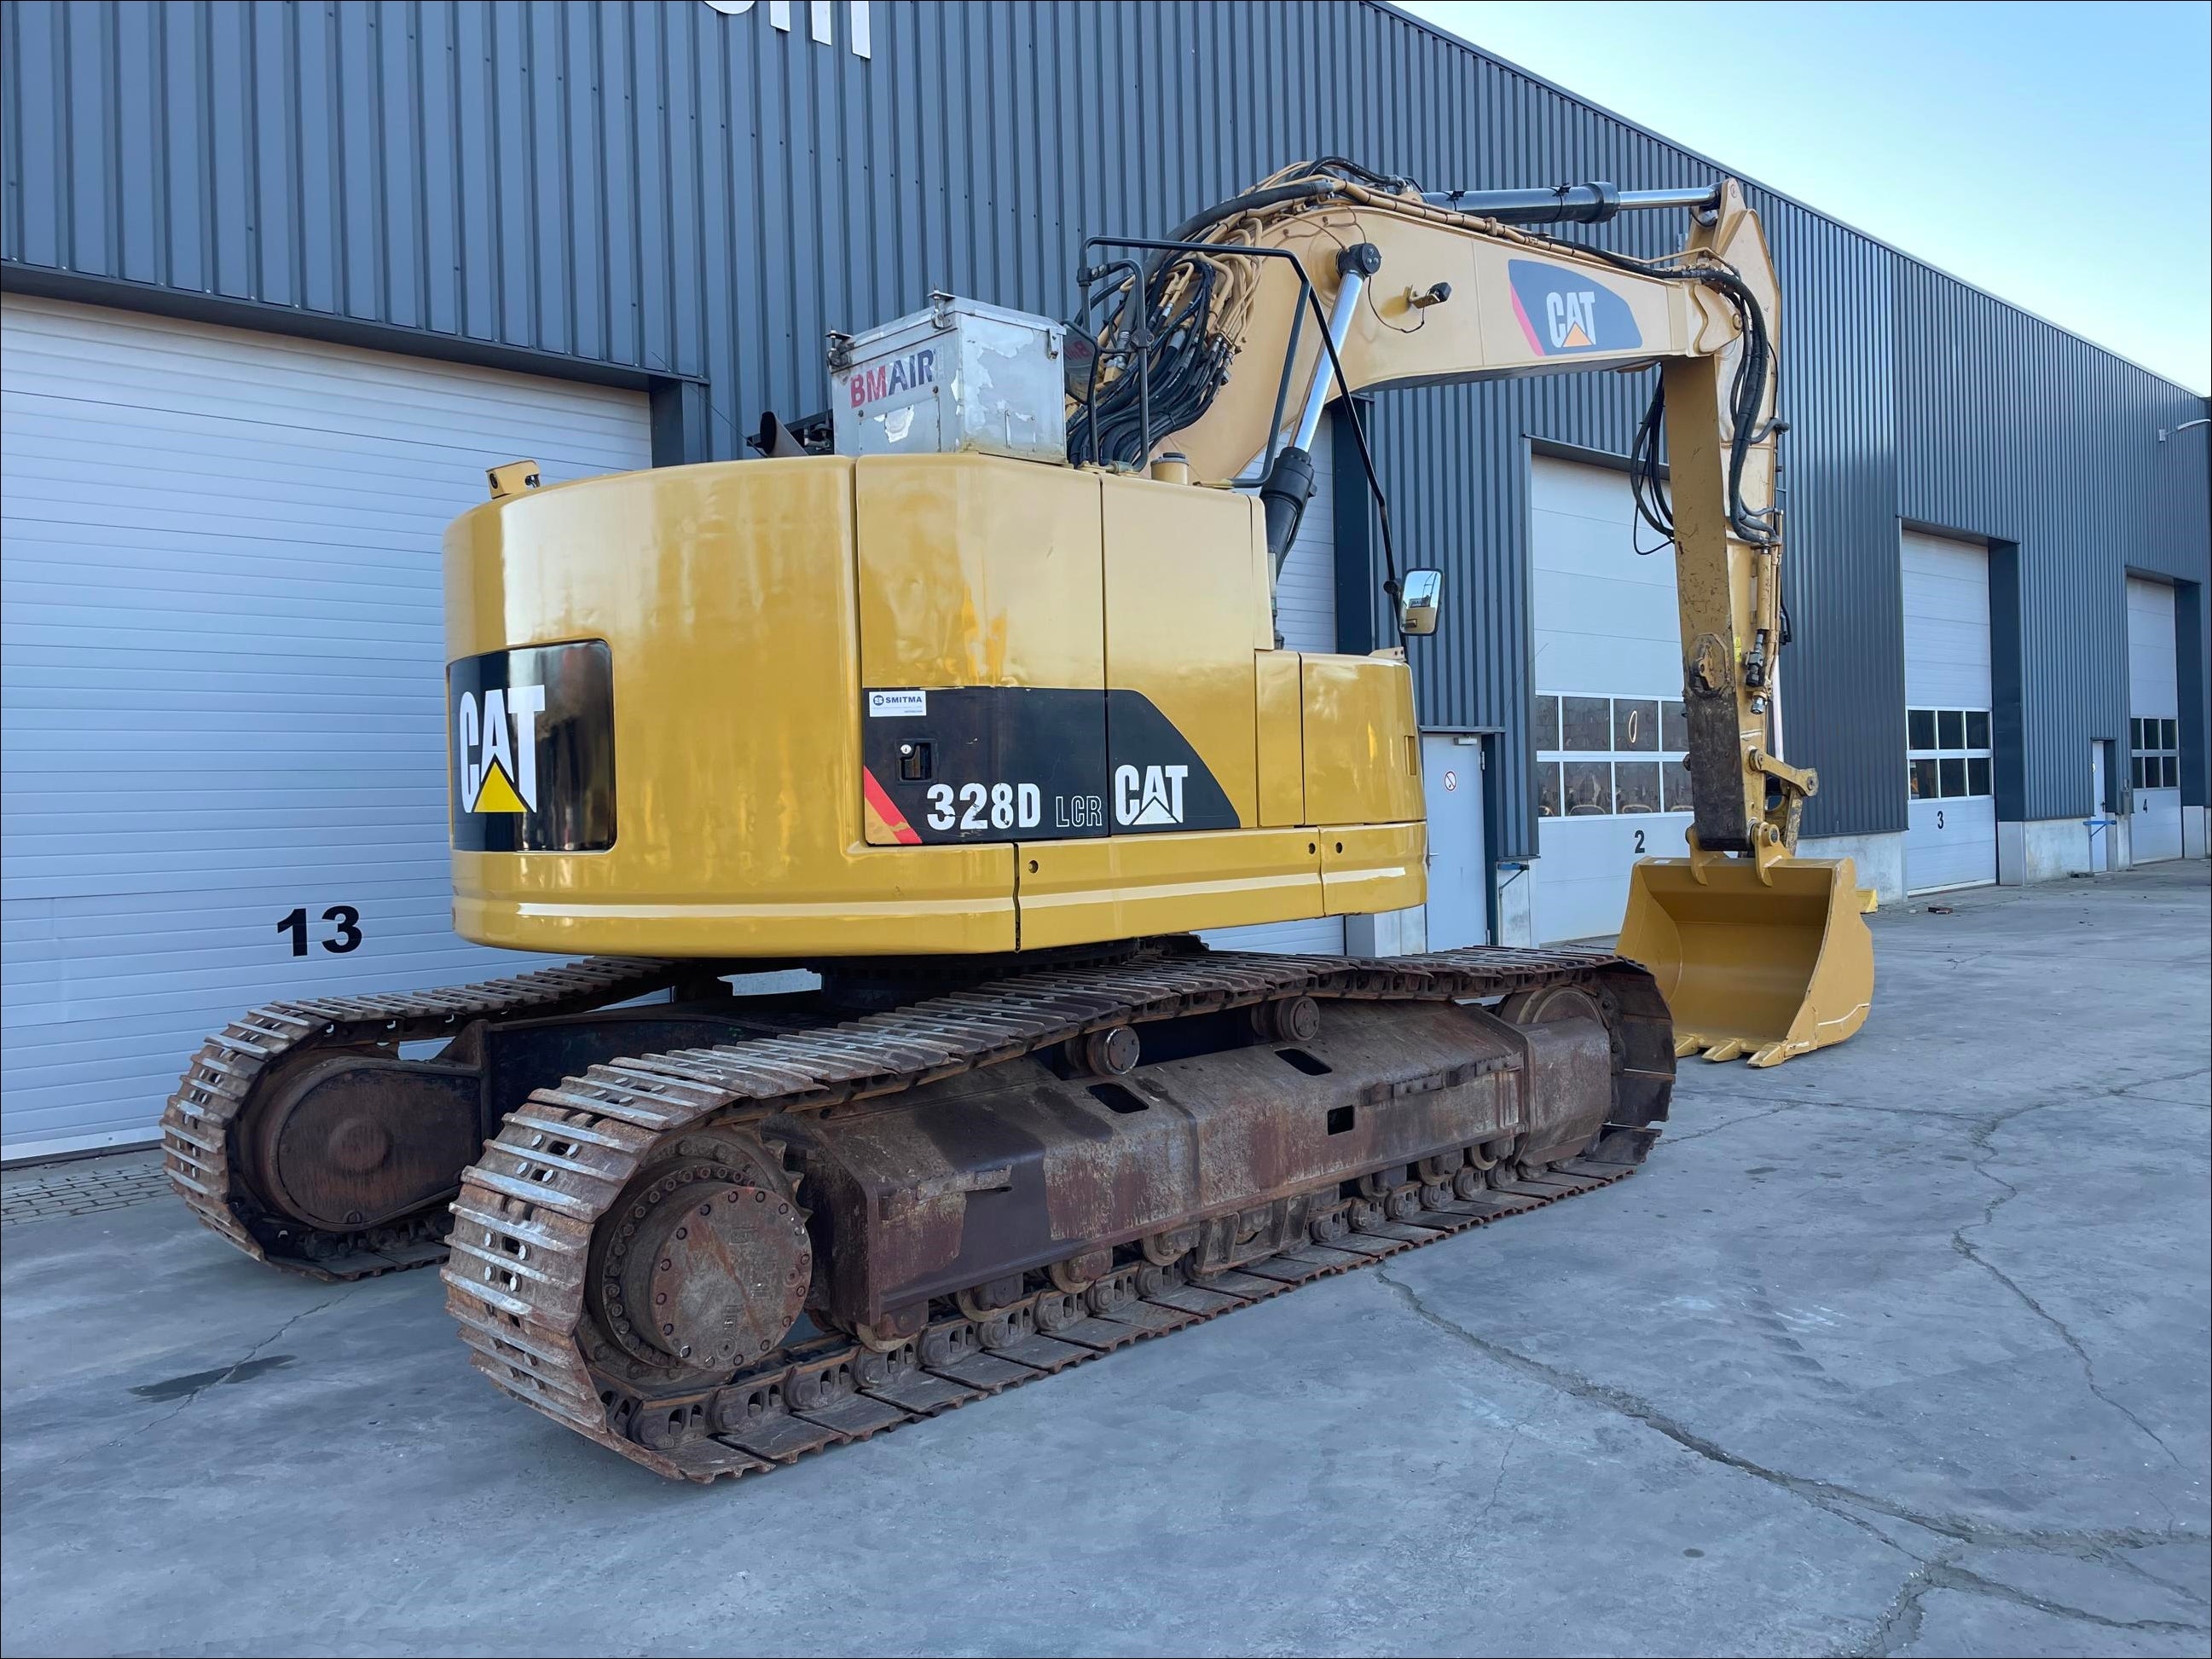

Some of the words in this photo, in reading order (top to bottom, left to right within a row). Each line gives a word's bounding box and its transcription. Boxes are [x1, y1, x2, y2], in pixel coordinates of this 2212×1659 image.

[1546, 291, 1596, 348] CAT
[849, 349, 934, 408] BMAIR
[460, 685, 546, 813] CAT
[926, 783, 1041, 830] 328D
[1056, 795, 1103, 828] LCR
[1115, 764, 1188, 826] CAT
[1937, 810, 1944, 830] 3
[2142, 798, 2148, 813] 4
[1634, 830, 1646, 854] 2
[276, 905, 362, 957] 13
